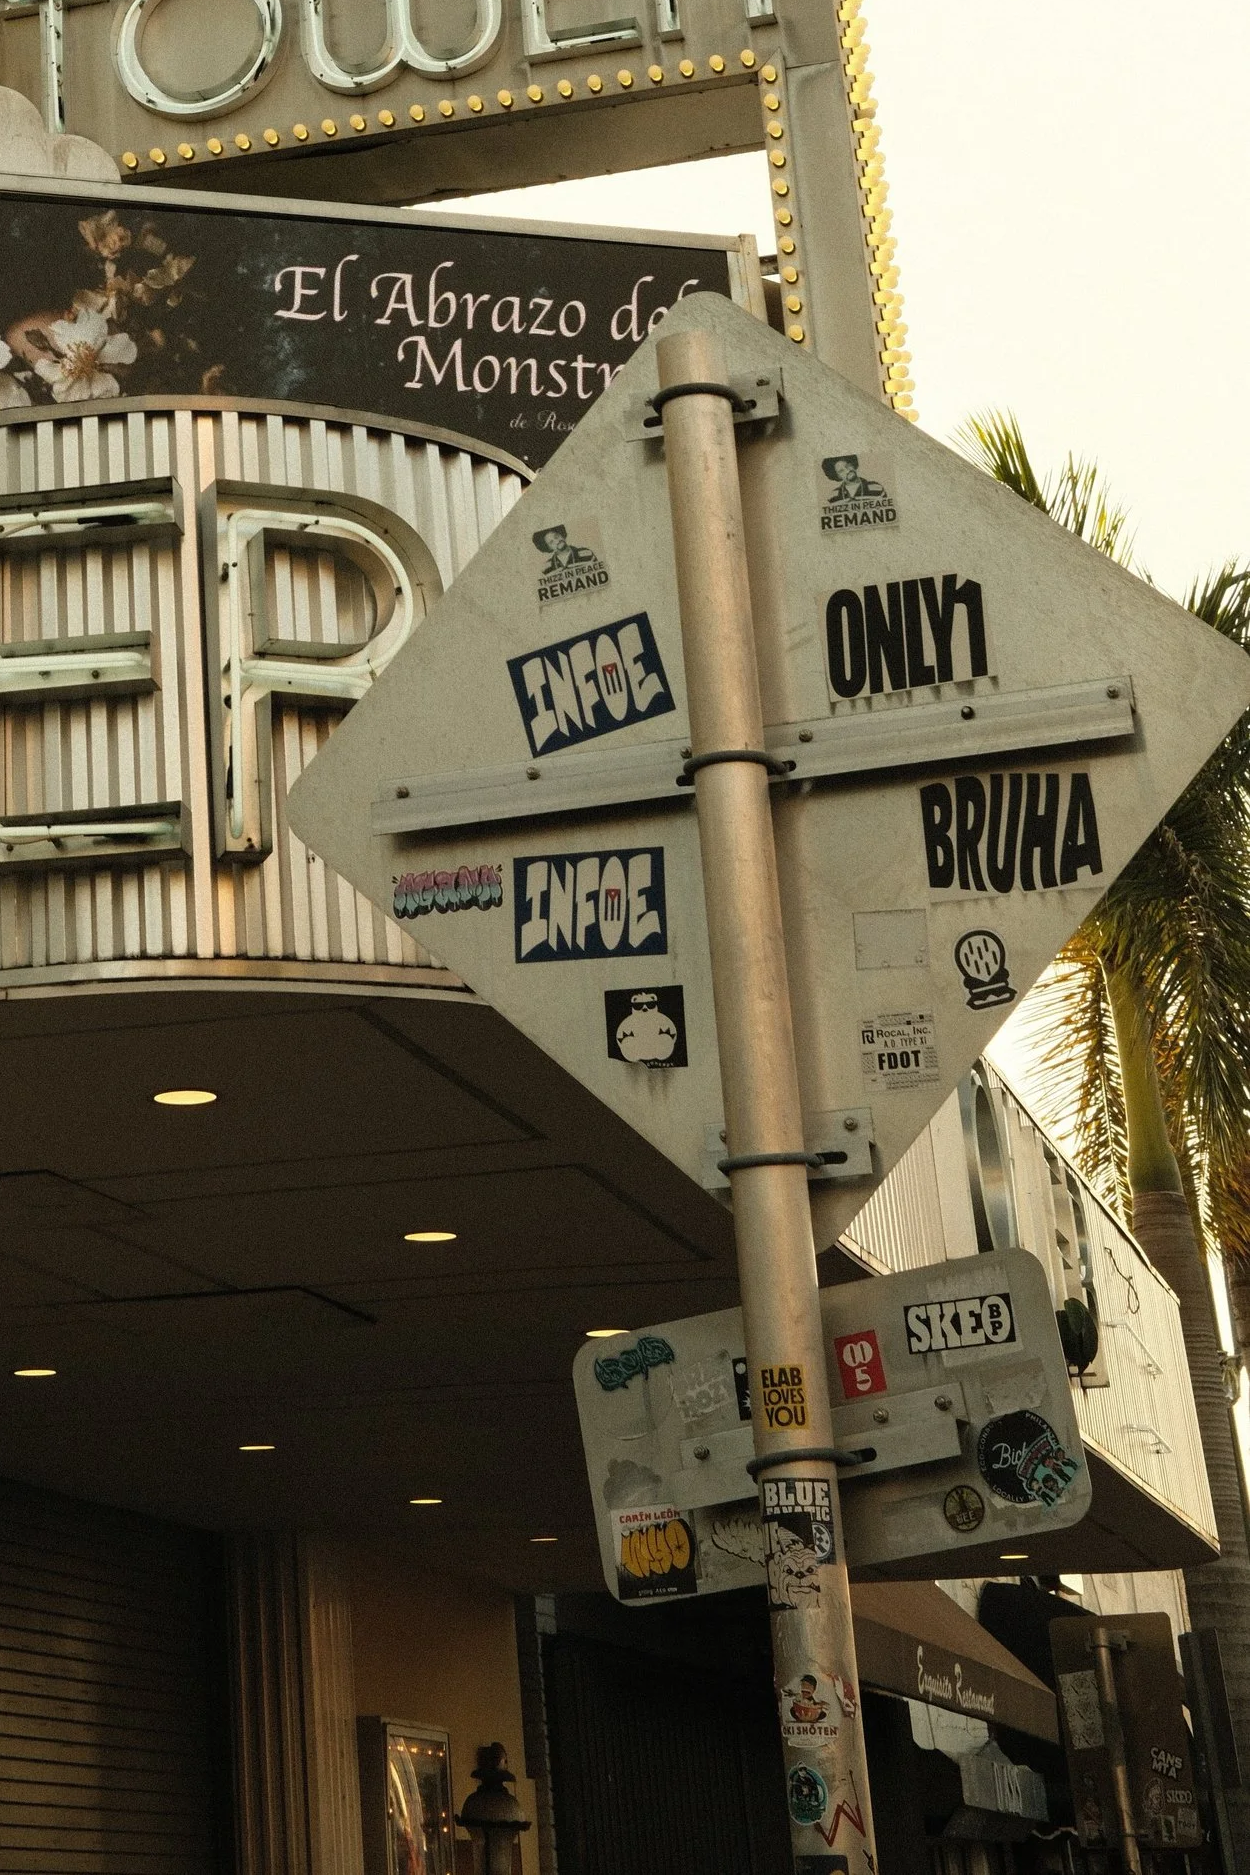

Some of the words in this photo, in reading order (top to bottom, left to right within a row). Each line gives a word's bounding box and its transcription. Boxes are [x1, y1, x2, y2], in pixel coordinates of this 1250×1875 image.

[274, 254, 360, 322] El
[371, 262, 586, 338] Abrazo
[510, 412, 527, 429] de
[822, 504, 849, 515] THIZZ
[851, 503, 860, 511] IN
[863, 498, 894, 509] PEACE
[821, 508, 897, 530] REMAND
[538, 574, 564, 586] THIZZ
[565, 569, 574, 579] IN
[576, 561, 605, 576] PEACE
[537, 570, 609, 601] REMAND
[521, 622, 665, 752] INFOE
[919, 772, 1103, 894] BRUHA
[521, 853, 662, 959] INFOE
[900, 1037, 917, 1047] TYPE
[878, 1050, 921, 1071] FDOT
[760, 1367, 803, 1389] ELAB
[763, 1388, 805, 1406] LOVES
[765, 1405, 806, 1427] YOU
[764, 1481, 830, 1507] BLUE
[992, 1485, 1024, 1502] LOCALLY
[1150, 1747, 1183, 1769] CANS
